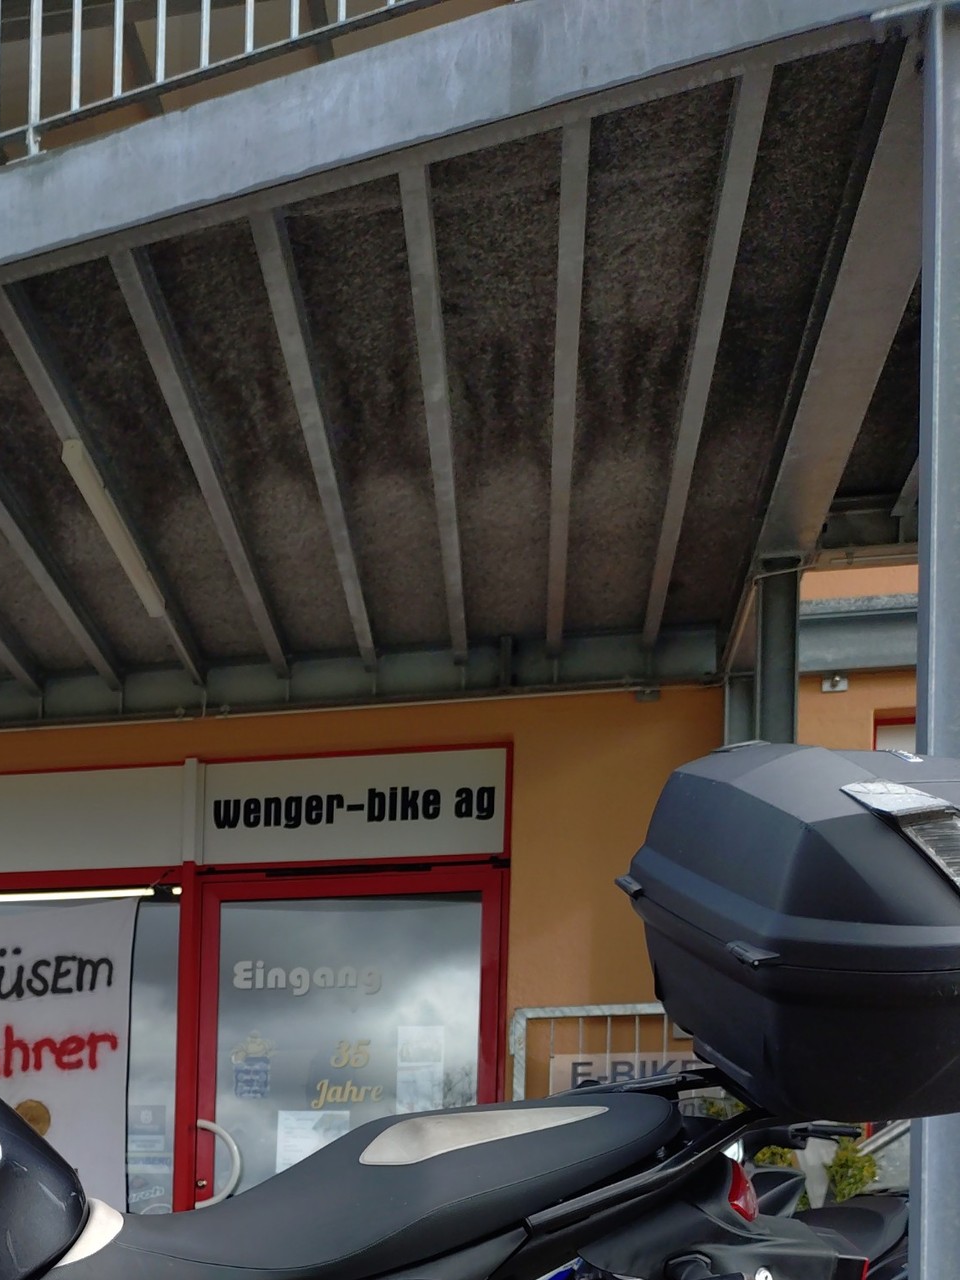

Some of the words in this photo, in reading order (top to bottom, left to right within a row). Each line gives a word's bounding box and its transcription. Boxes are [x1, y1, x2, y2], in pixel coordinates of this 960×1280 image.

[213, 786, 441, 829] wenger-bike
[454, 786, 496, 820] ag
[233, 960, 383, 996] Eingang
[330, 1039, 371, 1069] 35
[311, 1079, 383, 1109] Jahre
